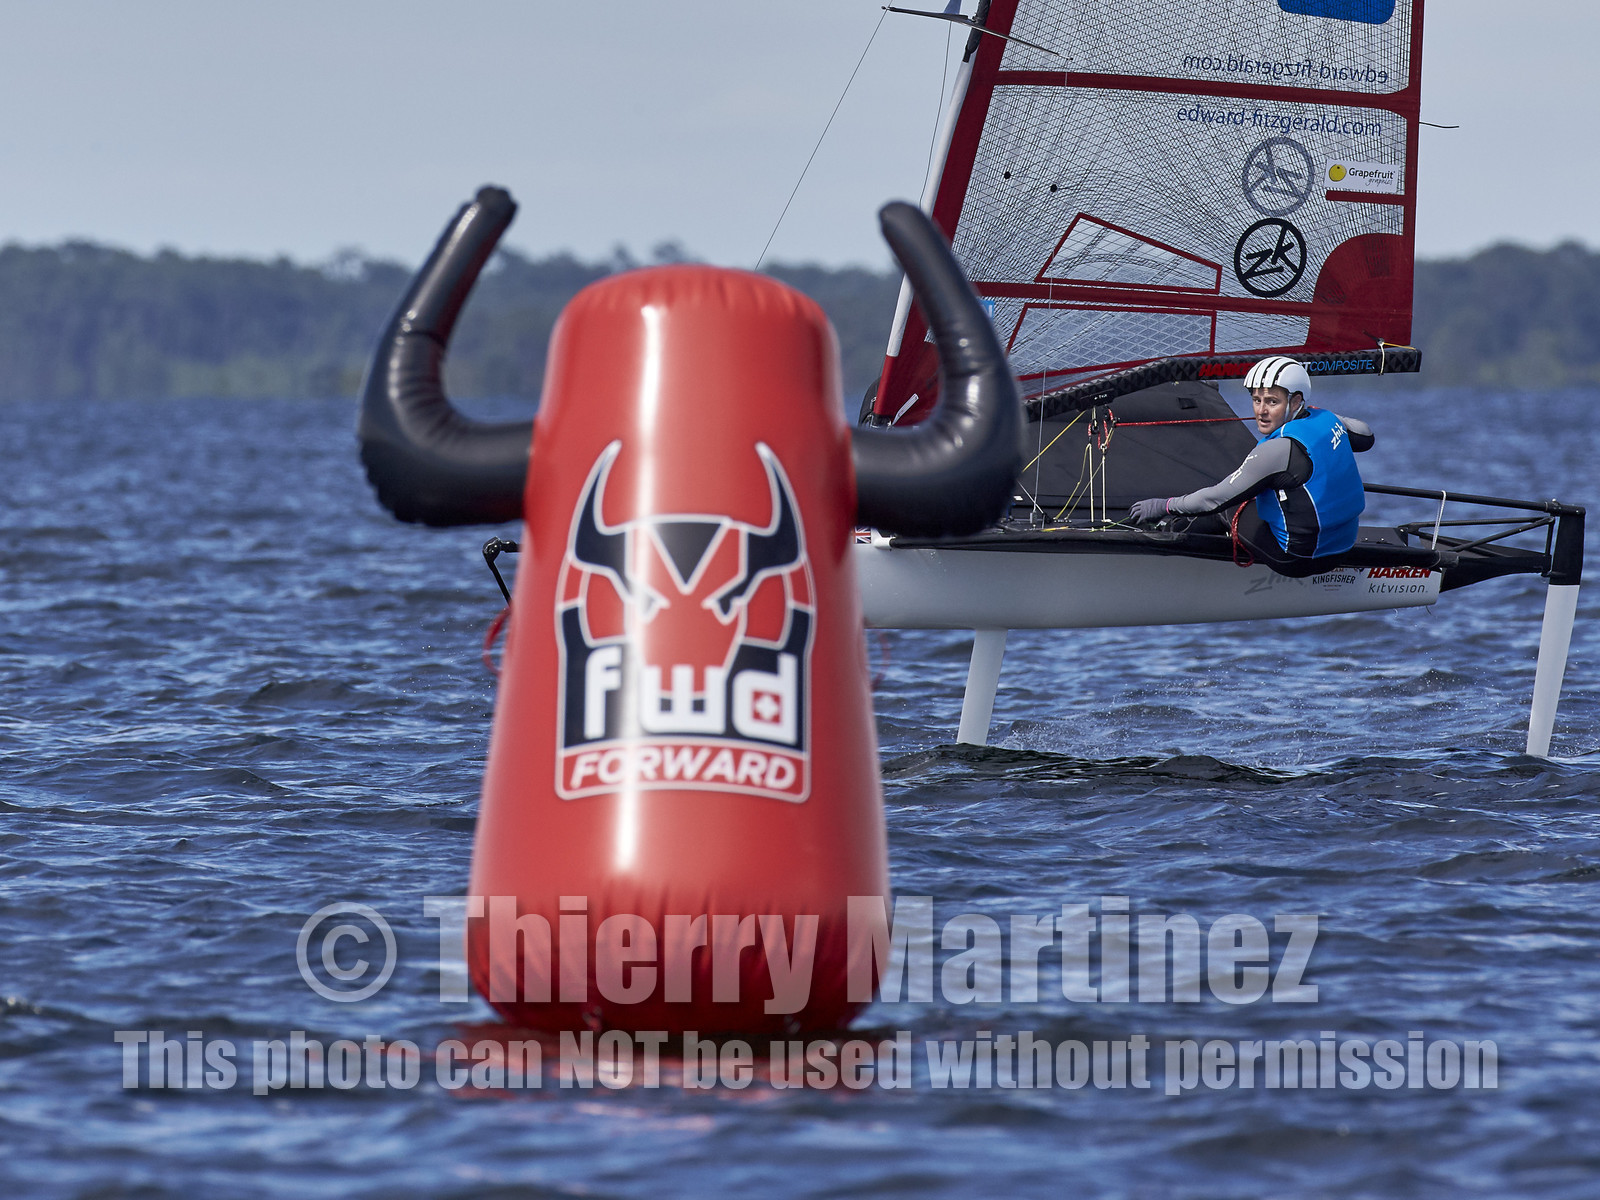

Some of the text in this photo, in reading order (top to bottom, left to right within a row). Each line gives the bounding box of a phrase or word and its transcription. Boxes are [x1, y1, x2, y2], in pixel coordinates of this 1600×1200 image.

[1176, 104, 1382, 137] edward-fitzgerald.com
[1348, 167, 1394, 180] Grapefruit
[1198, 362, 1257, 377] HARKE
[1312, 574, 1356, 585] KINGFISHER
[1367, 566, 1432, 579] HARKEN
[583, 645, 799, 747] fwd
[570, 745, 797, 789] FORWARD
